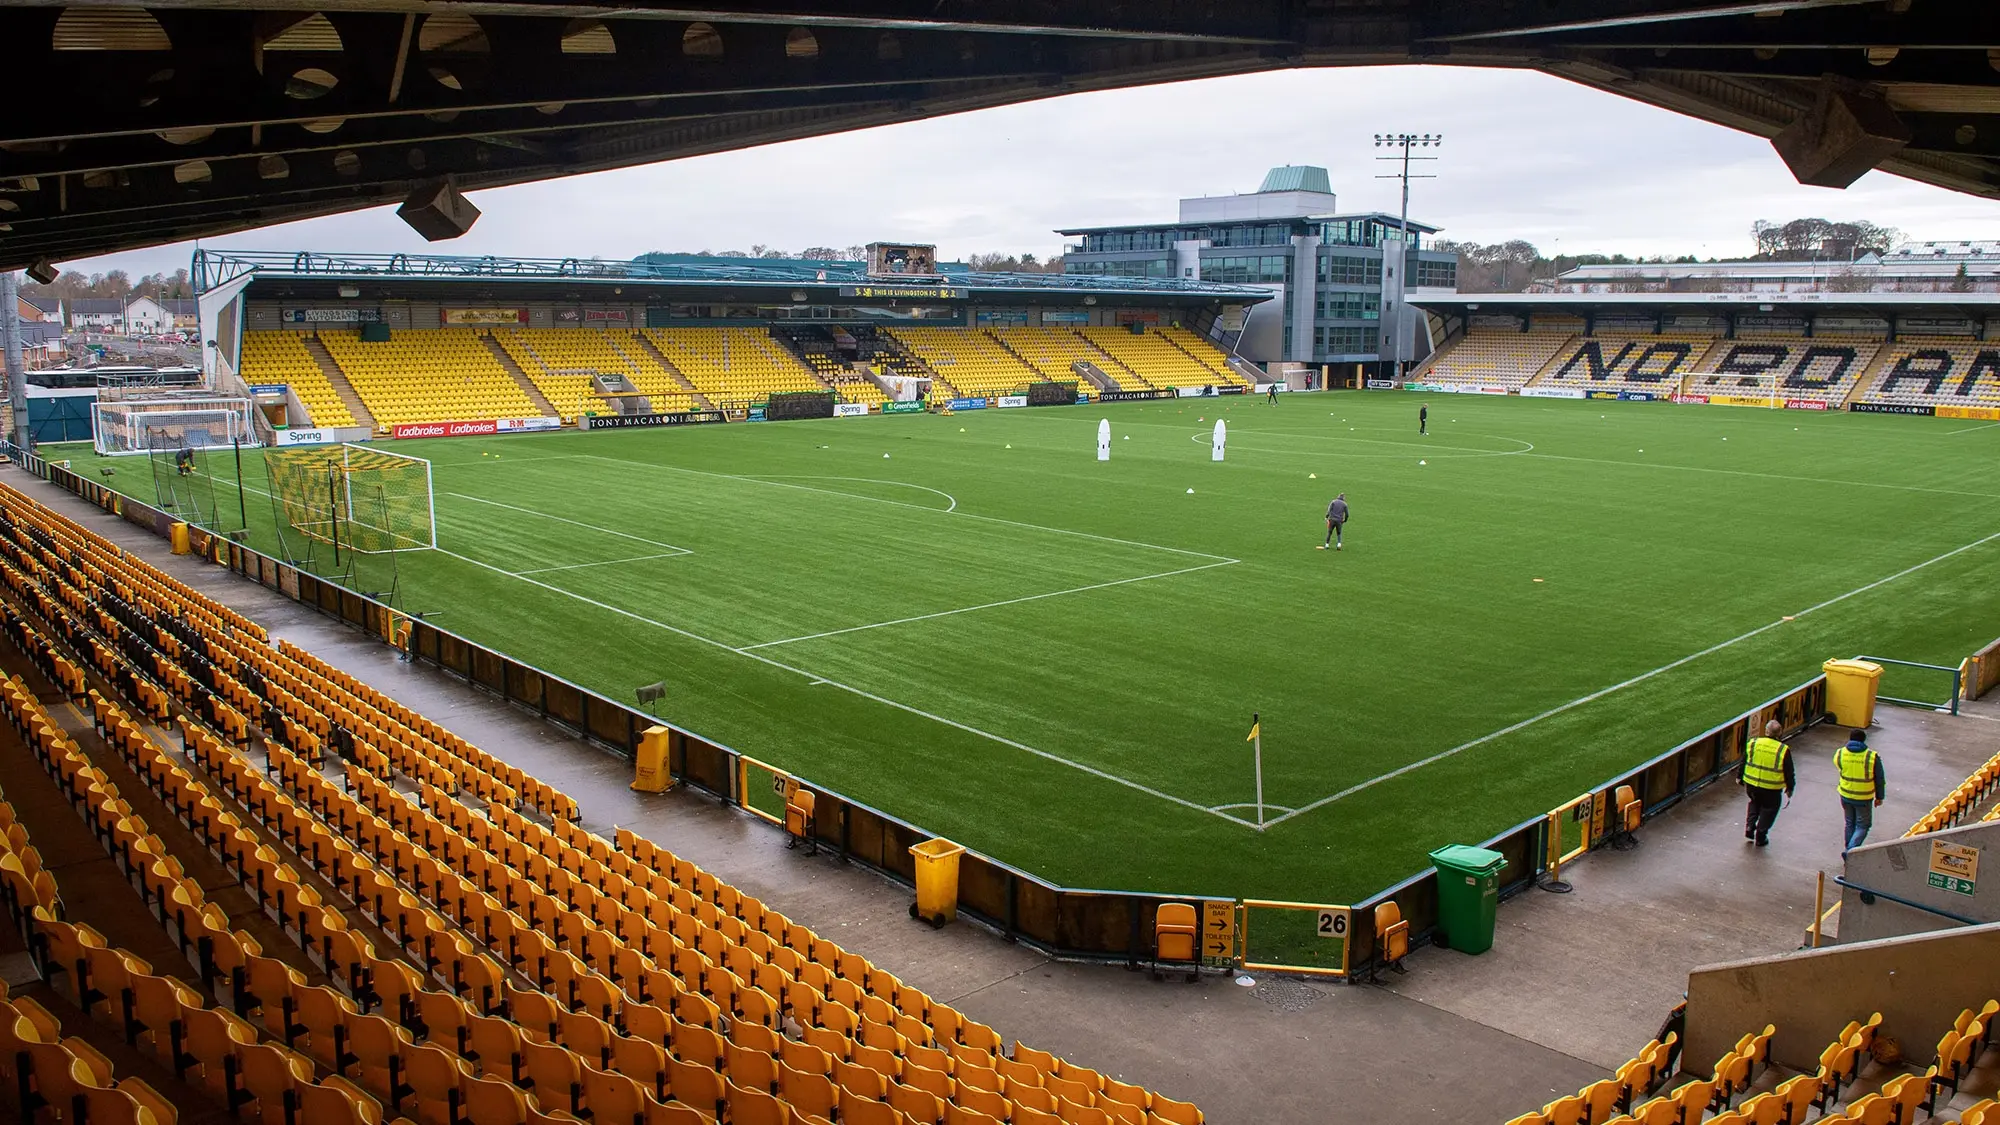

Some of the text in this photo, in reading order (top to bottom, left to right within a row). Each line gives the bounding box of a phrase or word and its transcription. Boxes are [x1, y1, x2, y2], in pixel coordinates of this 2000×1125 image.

[894, 289, 929, 297] LIVINGSTON
[1119, 392, 1153, 400] MACARONI
[840, 405, 861, 414] Spring
[893, 401, 920, 409] Greenfields
[1881, 406, 1930, 415] MACARONI
[590, 413, 721, 427] TONY MACARONI ARENA
[397, 422, 495, 437] Ladbrokes Ladbrokes
[289, 431, 322, 442] Spring
[774, 775, 786, 793] 27
[1579, 801, 1591, 820] 25
[1961, 848, 1977, 857] BAR
[1929, 879, 1944, 887] EXIT
[1319, 913, 1346, 934] 26
[1206, 933, 1232, 941] TOILETS
